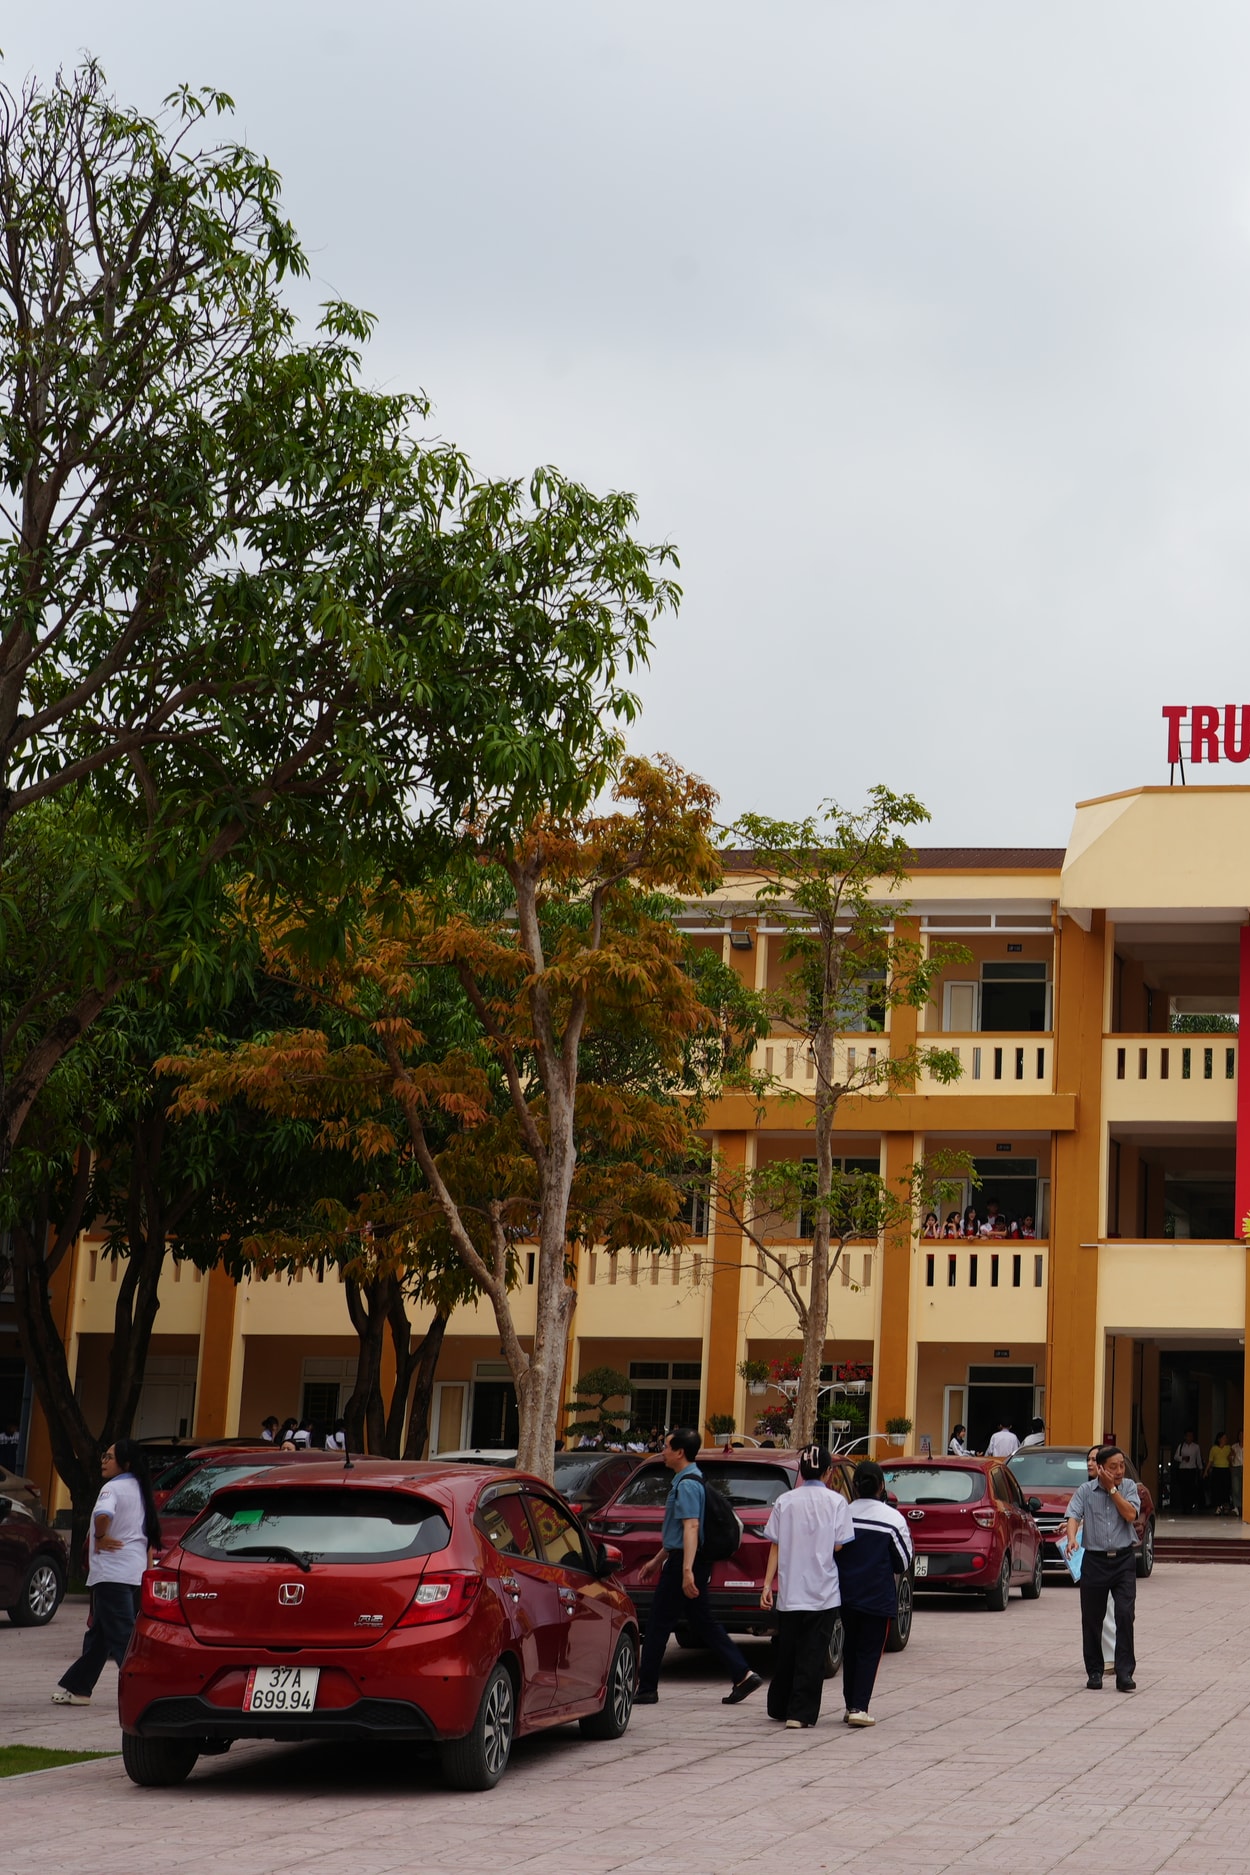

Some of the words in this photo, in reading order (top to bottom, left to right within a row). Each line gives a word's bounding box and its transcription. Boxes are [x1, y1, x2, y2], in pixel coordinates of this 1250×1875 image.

[186, 1592, 218, 1600] BRIO
[358, 1614, 384, 1622] RS
[269, 1668, 301, 1689] 37A
[252, 1690, 311, 1711] 699.94
